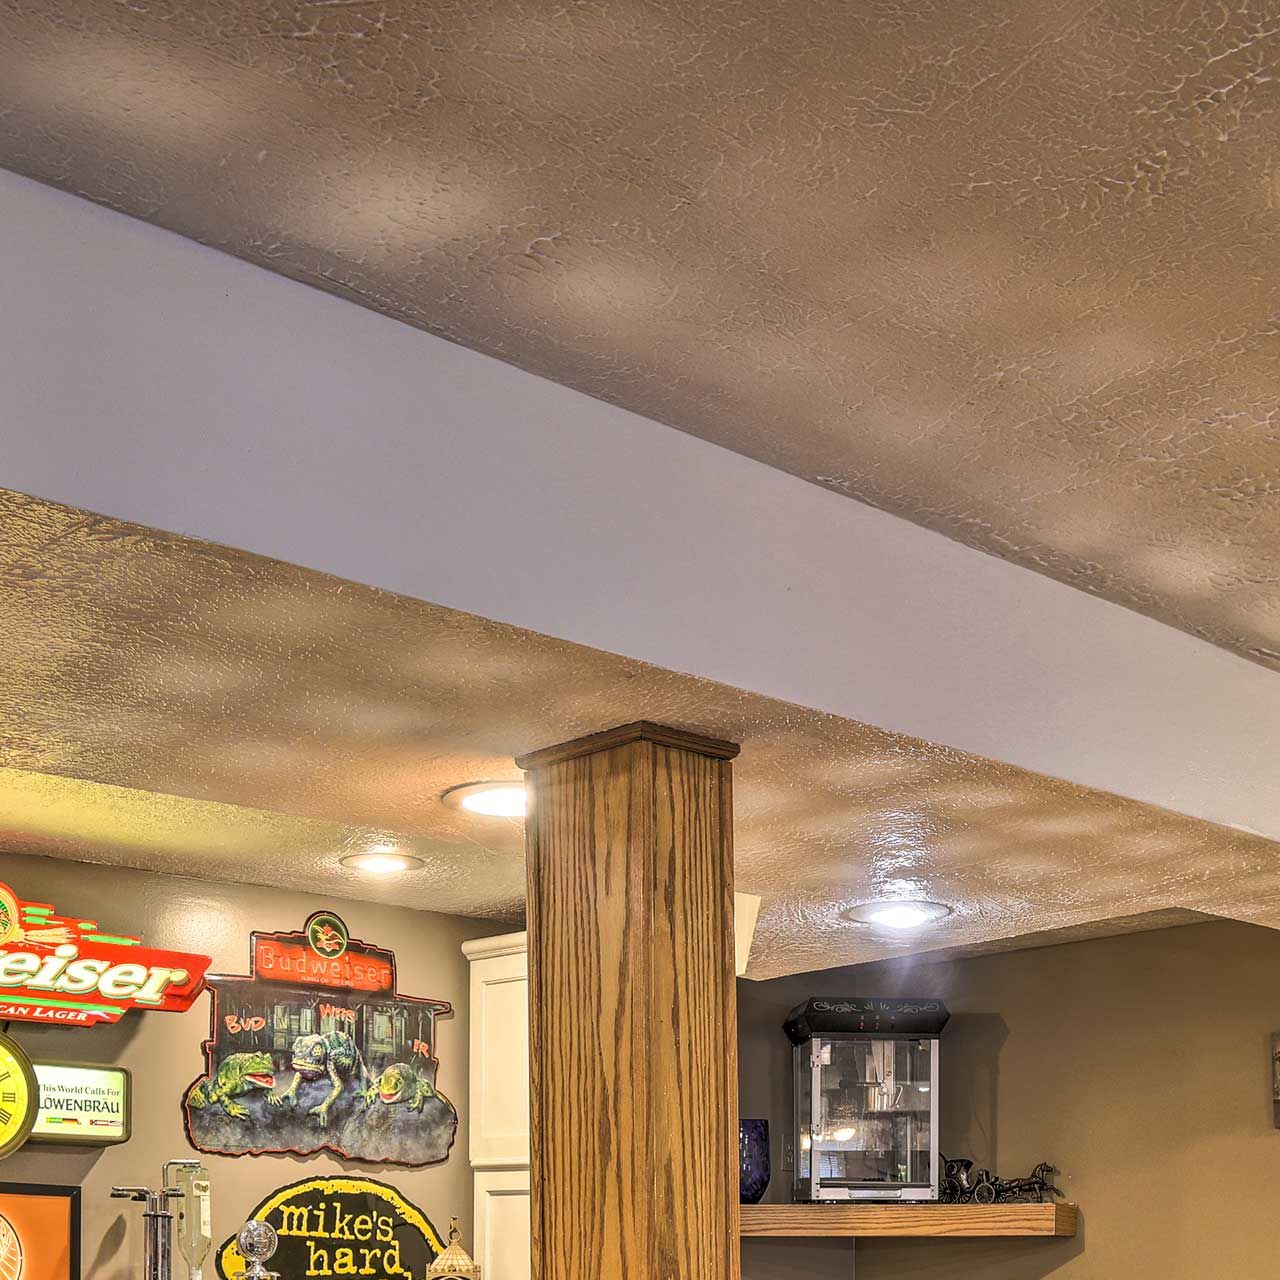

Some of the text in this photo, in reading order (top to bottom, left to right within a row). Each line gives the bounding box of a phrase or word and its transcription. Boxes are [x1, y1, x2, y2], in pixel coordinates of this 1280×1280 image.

[260, 946, 390, 983] Budweiser
[36, 1008, 88, 1021] LAGER
[224, 1014, 265, 1034] BUD
[57, 1085, 83, 1094] World
[84, 1087, 106, 1096] Calls
[107, 1088, 120, 1096] For
[277, 1202, 393, 1242] mike's
[305, 1240, 404, 1276] hard
